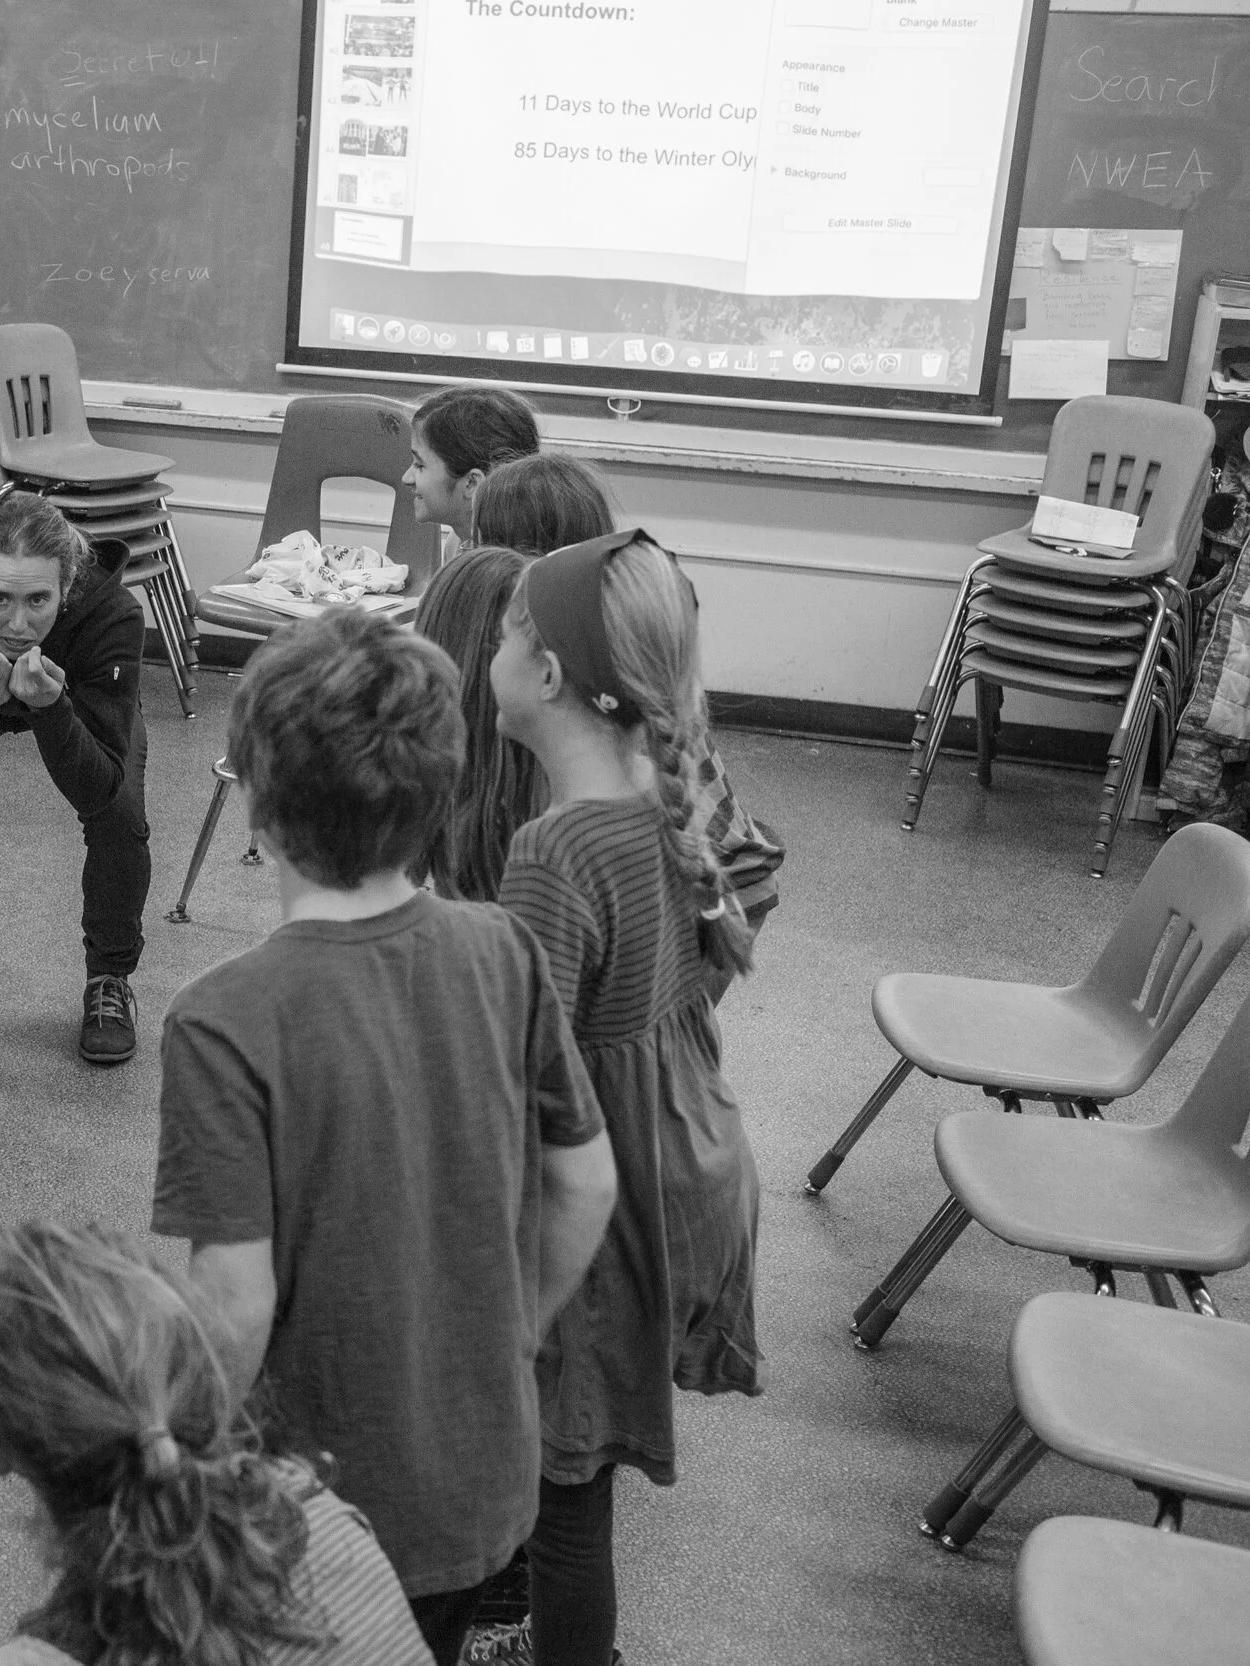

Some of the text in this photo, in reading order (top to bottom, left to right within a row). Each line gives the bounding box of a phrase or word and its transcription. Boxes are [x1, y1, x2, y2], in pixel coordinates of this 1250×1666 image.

[465, 0, 635, 21] The Countdown:
[899, 17, 978, 29] Change Master
[781, 59, 846, 73] Appearance
[797, 81, 820, 93] Title
[518, 94, 758, 124] 11 Days to the World Cup
[794, 102, 822, 116] Body
[4, 94, 163, 154] mycelium
[792, 124, 862, 139] Slide Number
[513, 141, 758, 172] 85 Days to the Winter Oly
[10, 144, 191, 194] arthropods
[784, 166, 848, 180] Background
[1067, 147, 1214, 188] NWEA
[827, 218, 912, 229] Edit Master Slide
[39, 262, 138, 300] Zoey
